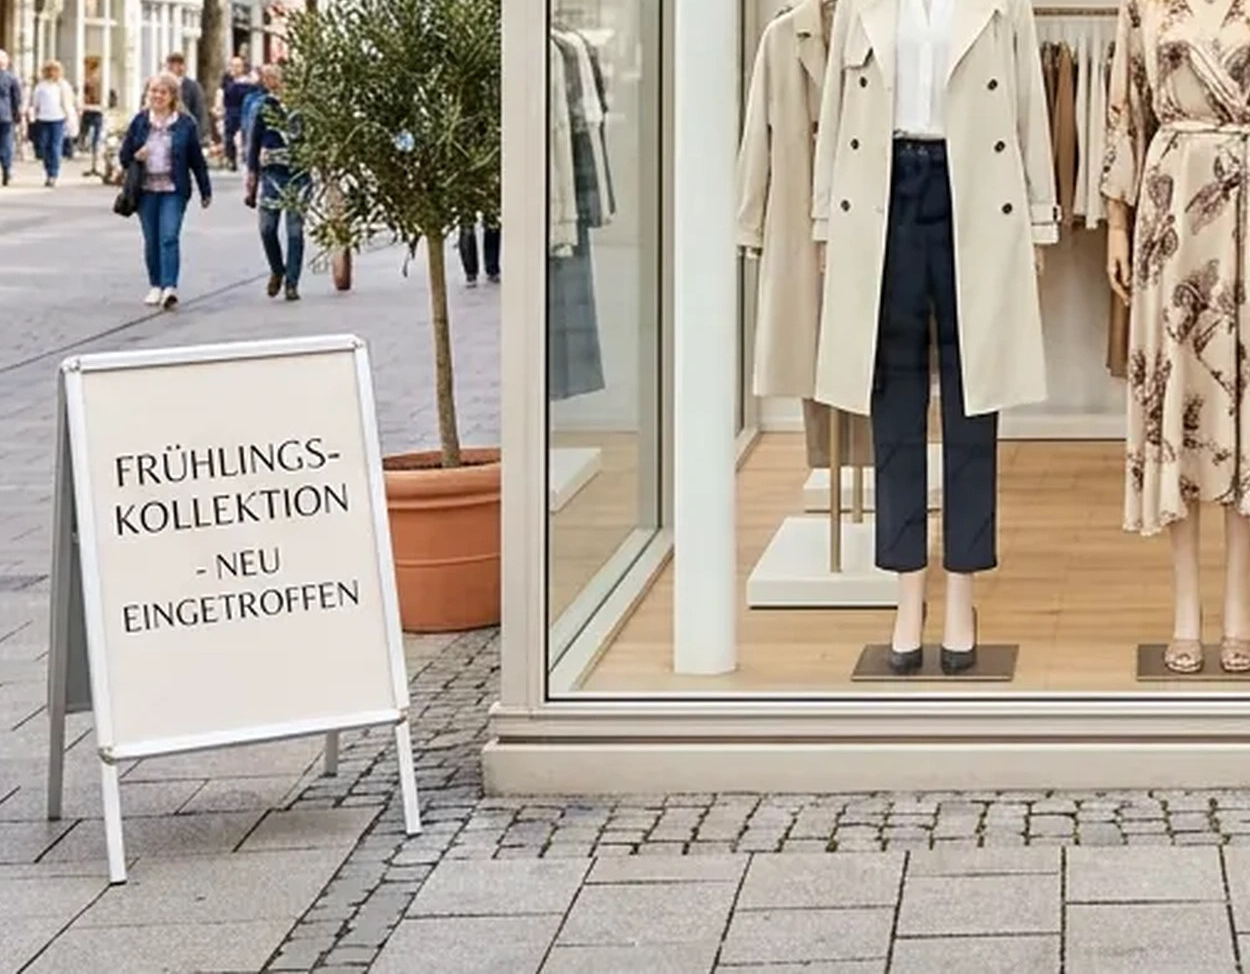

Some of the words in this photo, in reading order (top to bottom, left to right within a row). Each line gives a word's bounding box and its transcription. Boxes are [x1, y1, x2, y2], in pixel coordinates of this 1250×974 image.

[115, 438, 341, 487] FRÜHLINGS-
[115, 483, 349, 536] KOLLEKTION
[216, 547, 281, 579] NEU
[123, 580, 360, 633] EINGETROFFEN
